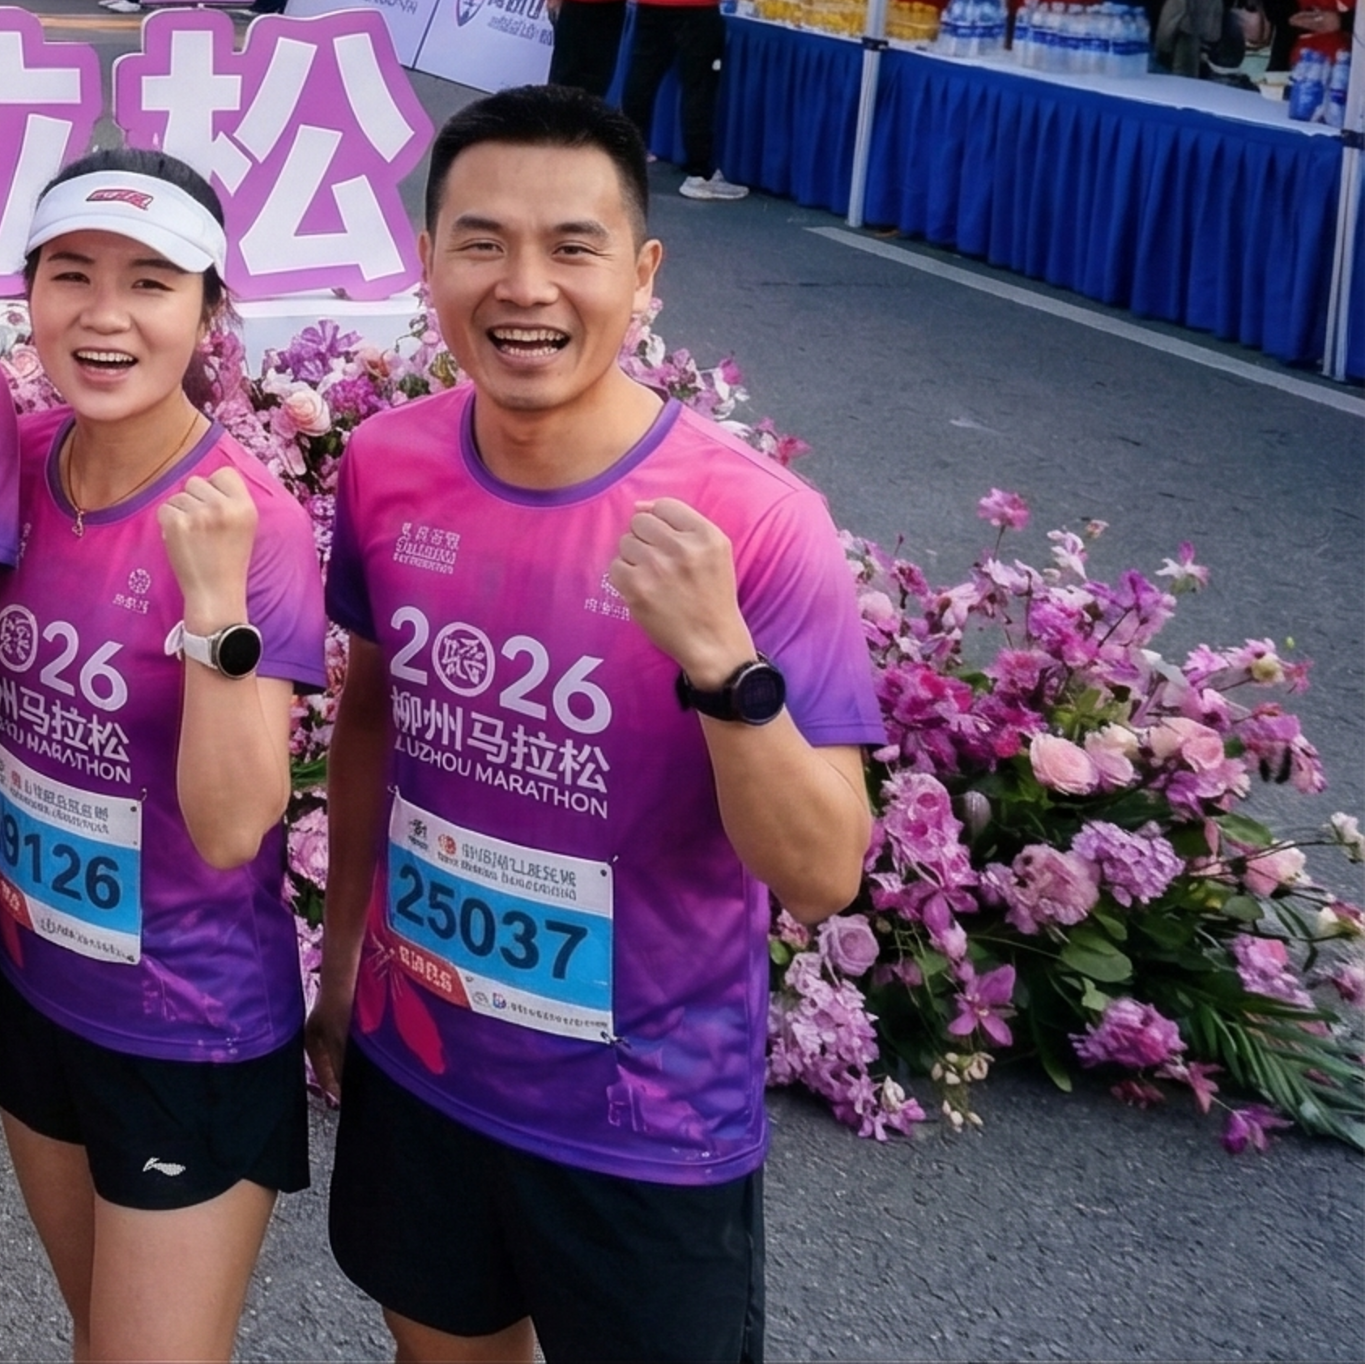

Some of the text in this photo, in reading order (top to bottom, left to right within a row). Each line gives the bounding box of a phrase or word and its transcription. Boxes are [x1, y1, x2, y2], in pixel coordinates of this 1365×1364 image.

[389, 605, 613, 735] 2026
[390, 684, 610, 794] 柳州马拉松
[475, 763, 609, 820] MARATHON
[395, 862, 589, 981] 25037
